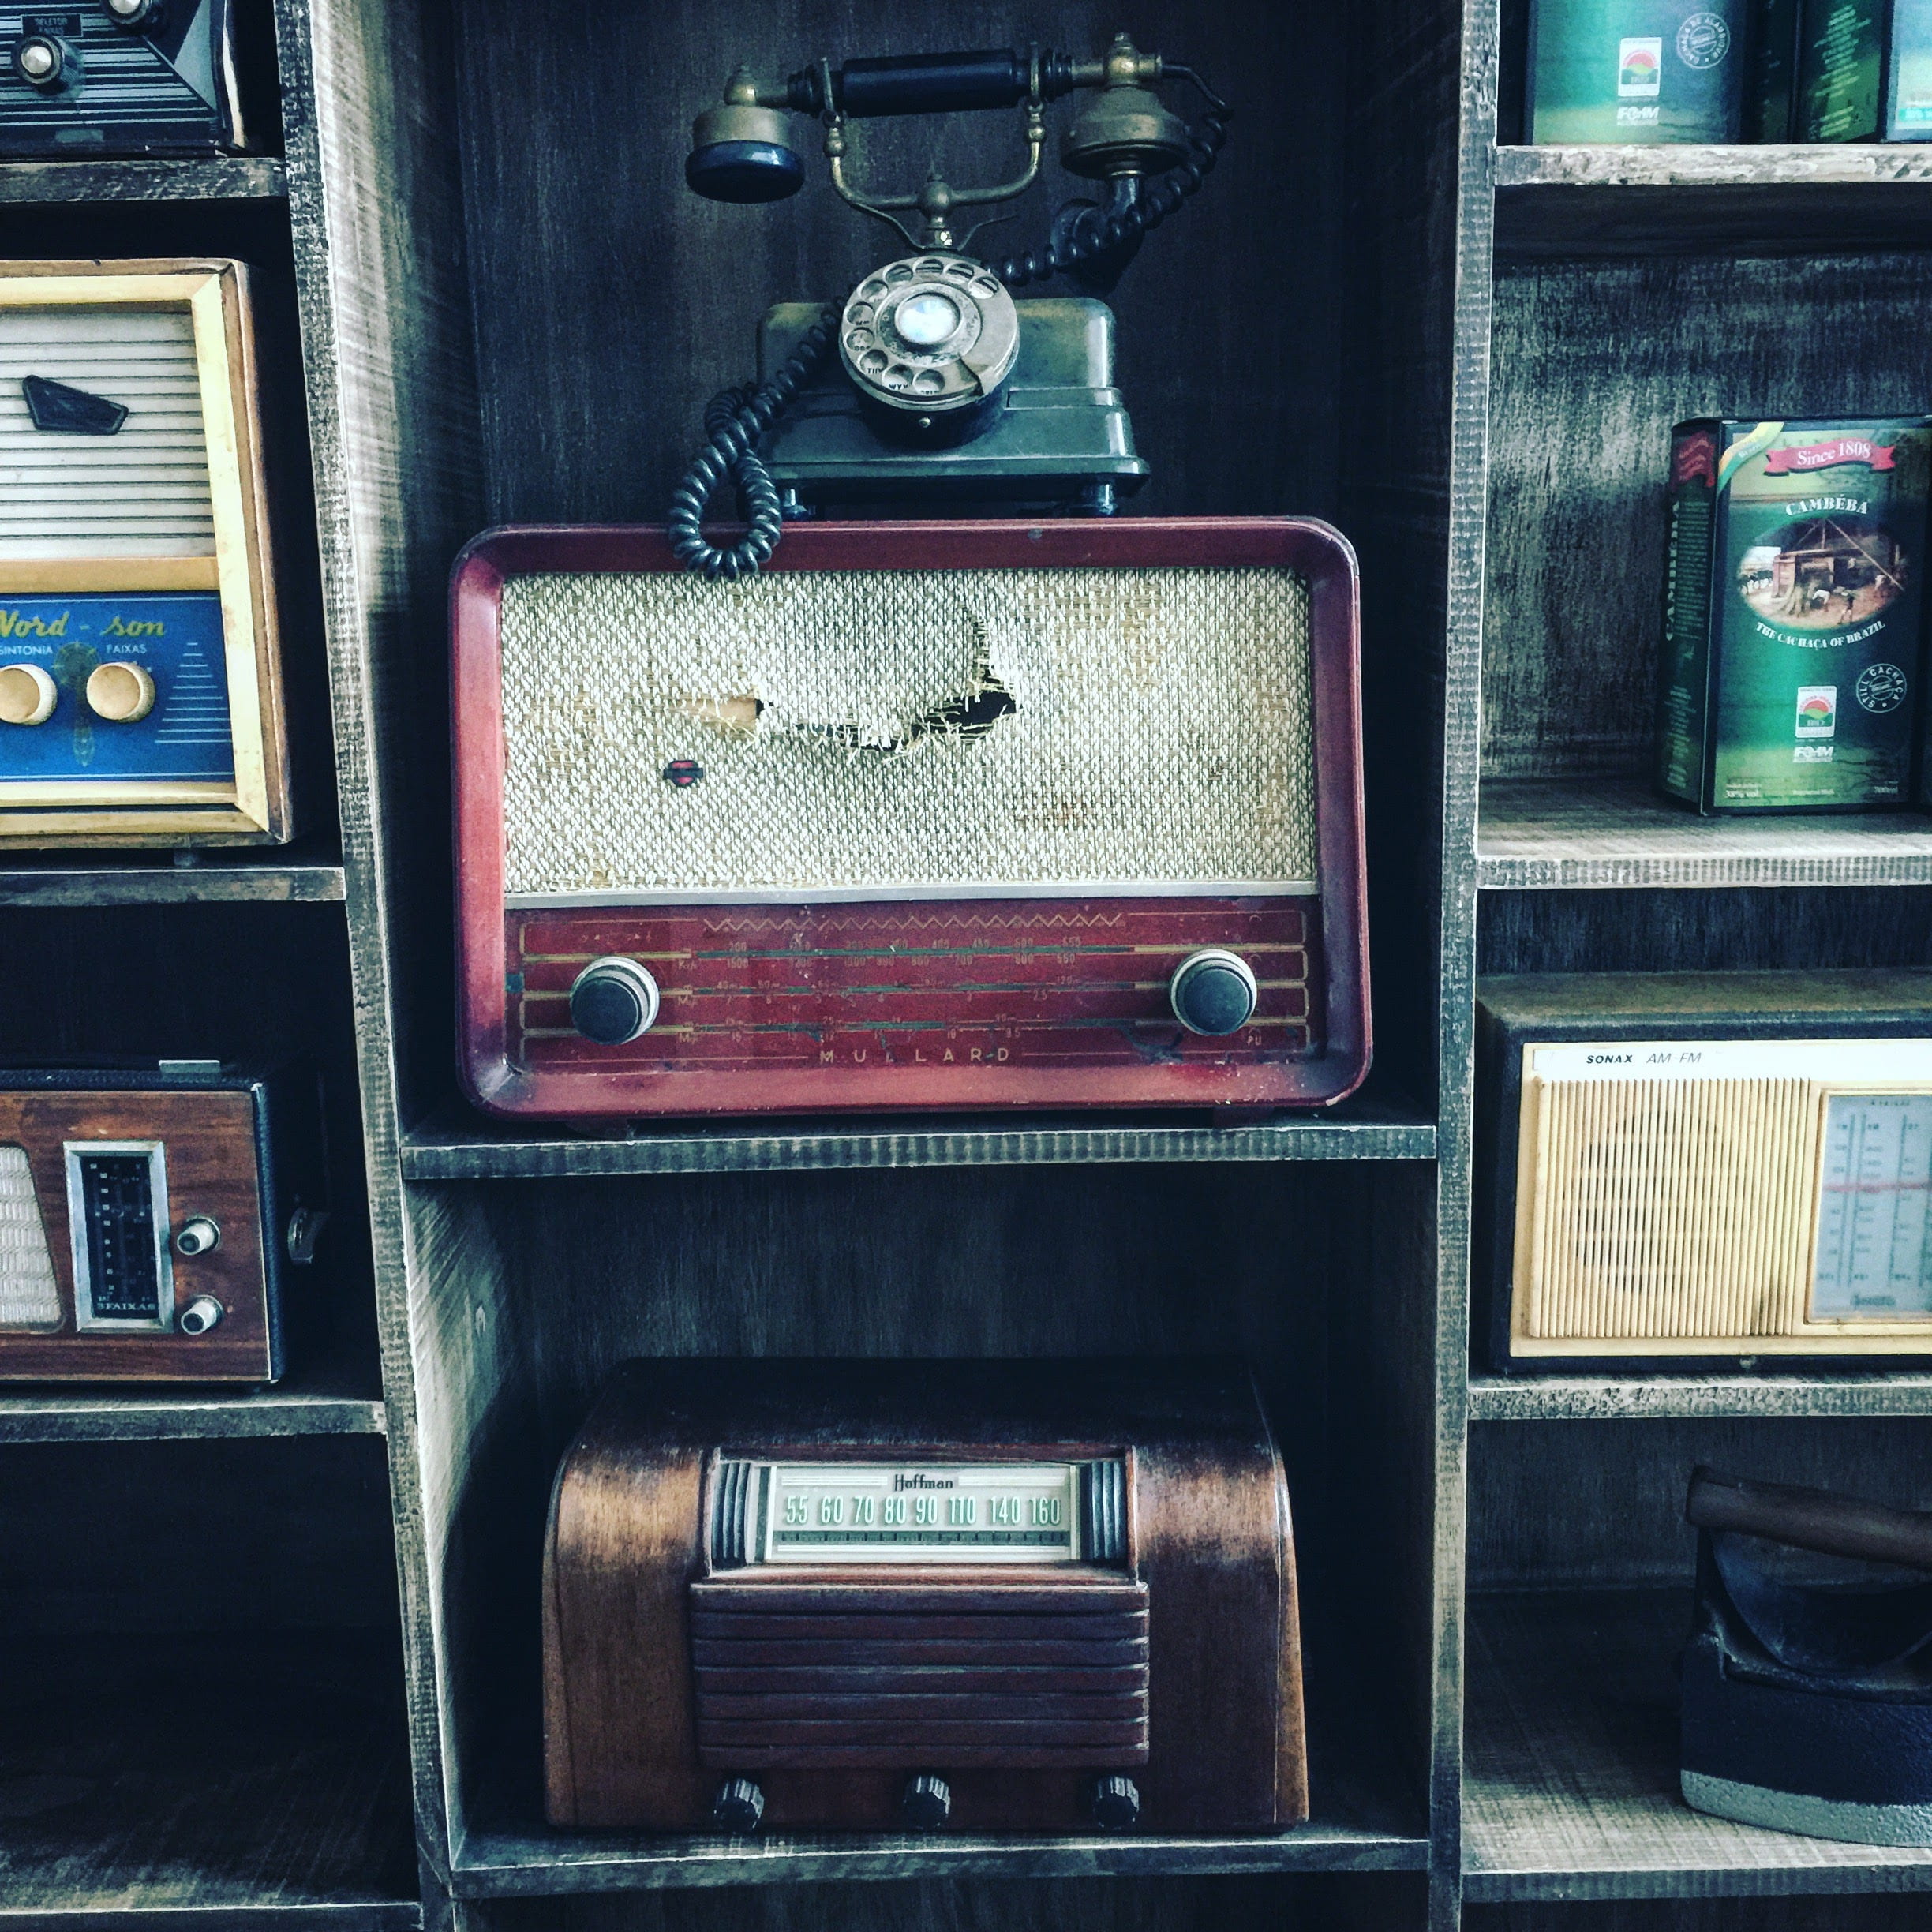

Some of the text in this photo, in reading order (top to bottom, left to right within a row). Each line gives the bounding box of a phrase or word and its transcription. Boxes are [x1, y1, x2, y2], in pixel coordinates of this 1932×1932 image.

[1796, 440, 1872, 466] Since 1808
[1785, 494, 1868, 516] CAMBÉBA
[99, 615, 166, 637] son
[1756, 620, 1886, 651] THE CACHAÇA OF BRAZIL
[106, 644, 147, 654] FAIXAS
[1859, 680, 1876, 708] STILL
[1870, 667, 1904, 701] CACHAÇA
[819, 1047, 1009, 1064] MULLARD
[1586, 1053, 1702, 1064] SONAX AM FM
[894, 1474, 953, 1492] Hoffman
[786, 1496, 1061, 1525] 55 60 70 80 90 110 140 160
